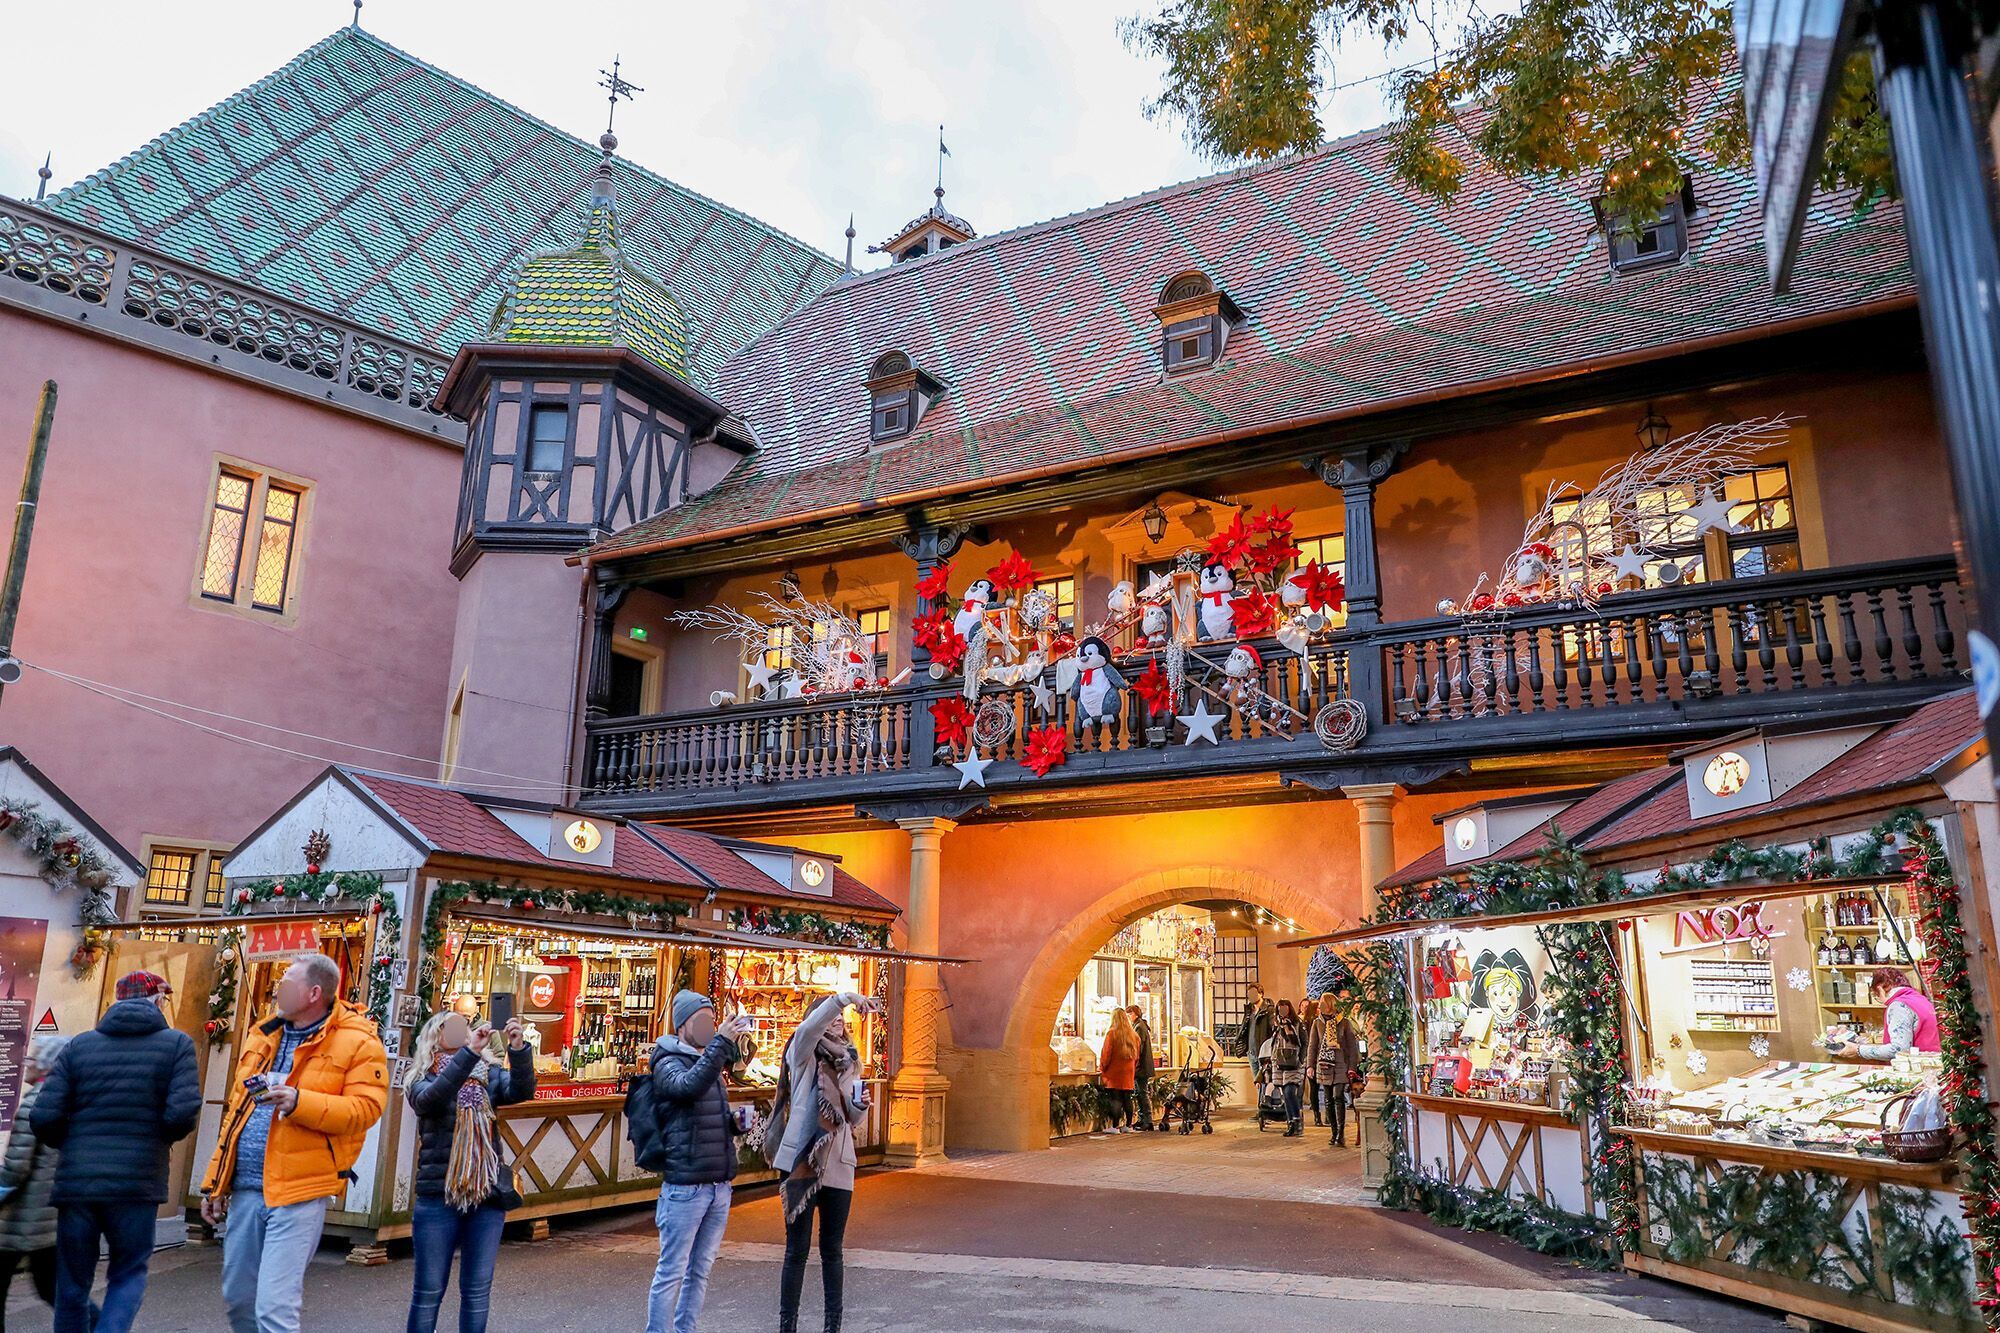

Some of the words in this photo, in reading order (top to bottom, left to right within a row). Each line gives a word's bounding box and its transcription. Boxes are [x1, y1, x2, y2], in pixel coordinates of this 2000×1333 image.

[248, 923, 317, 953] AWA
[532, 983, 554, 999] perle
[534, 1089, 563, 1099] STING
[571, 1086, 617, 1097] DÉGUSTAT
